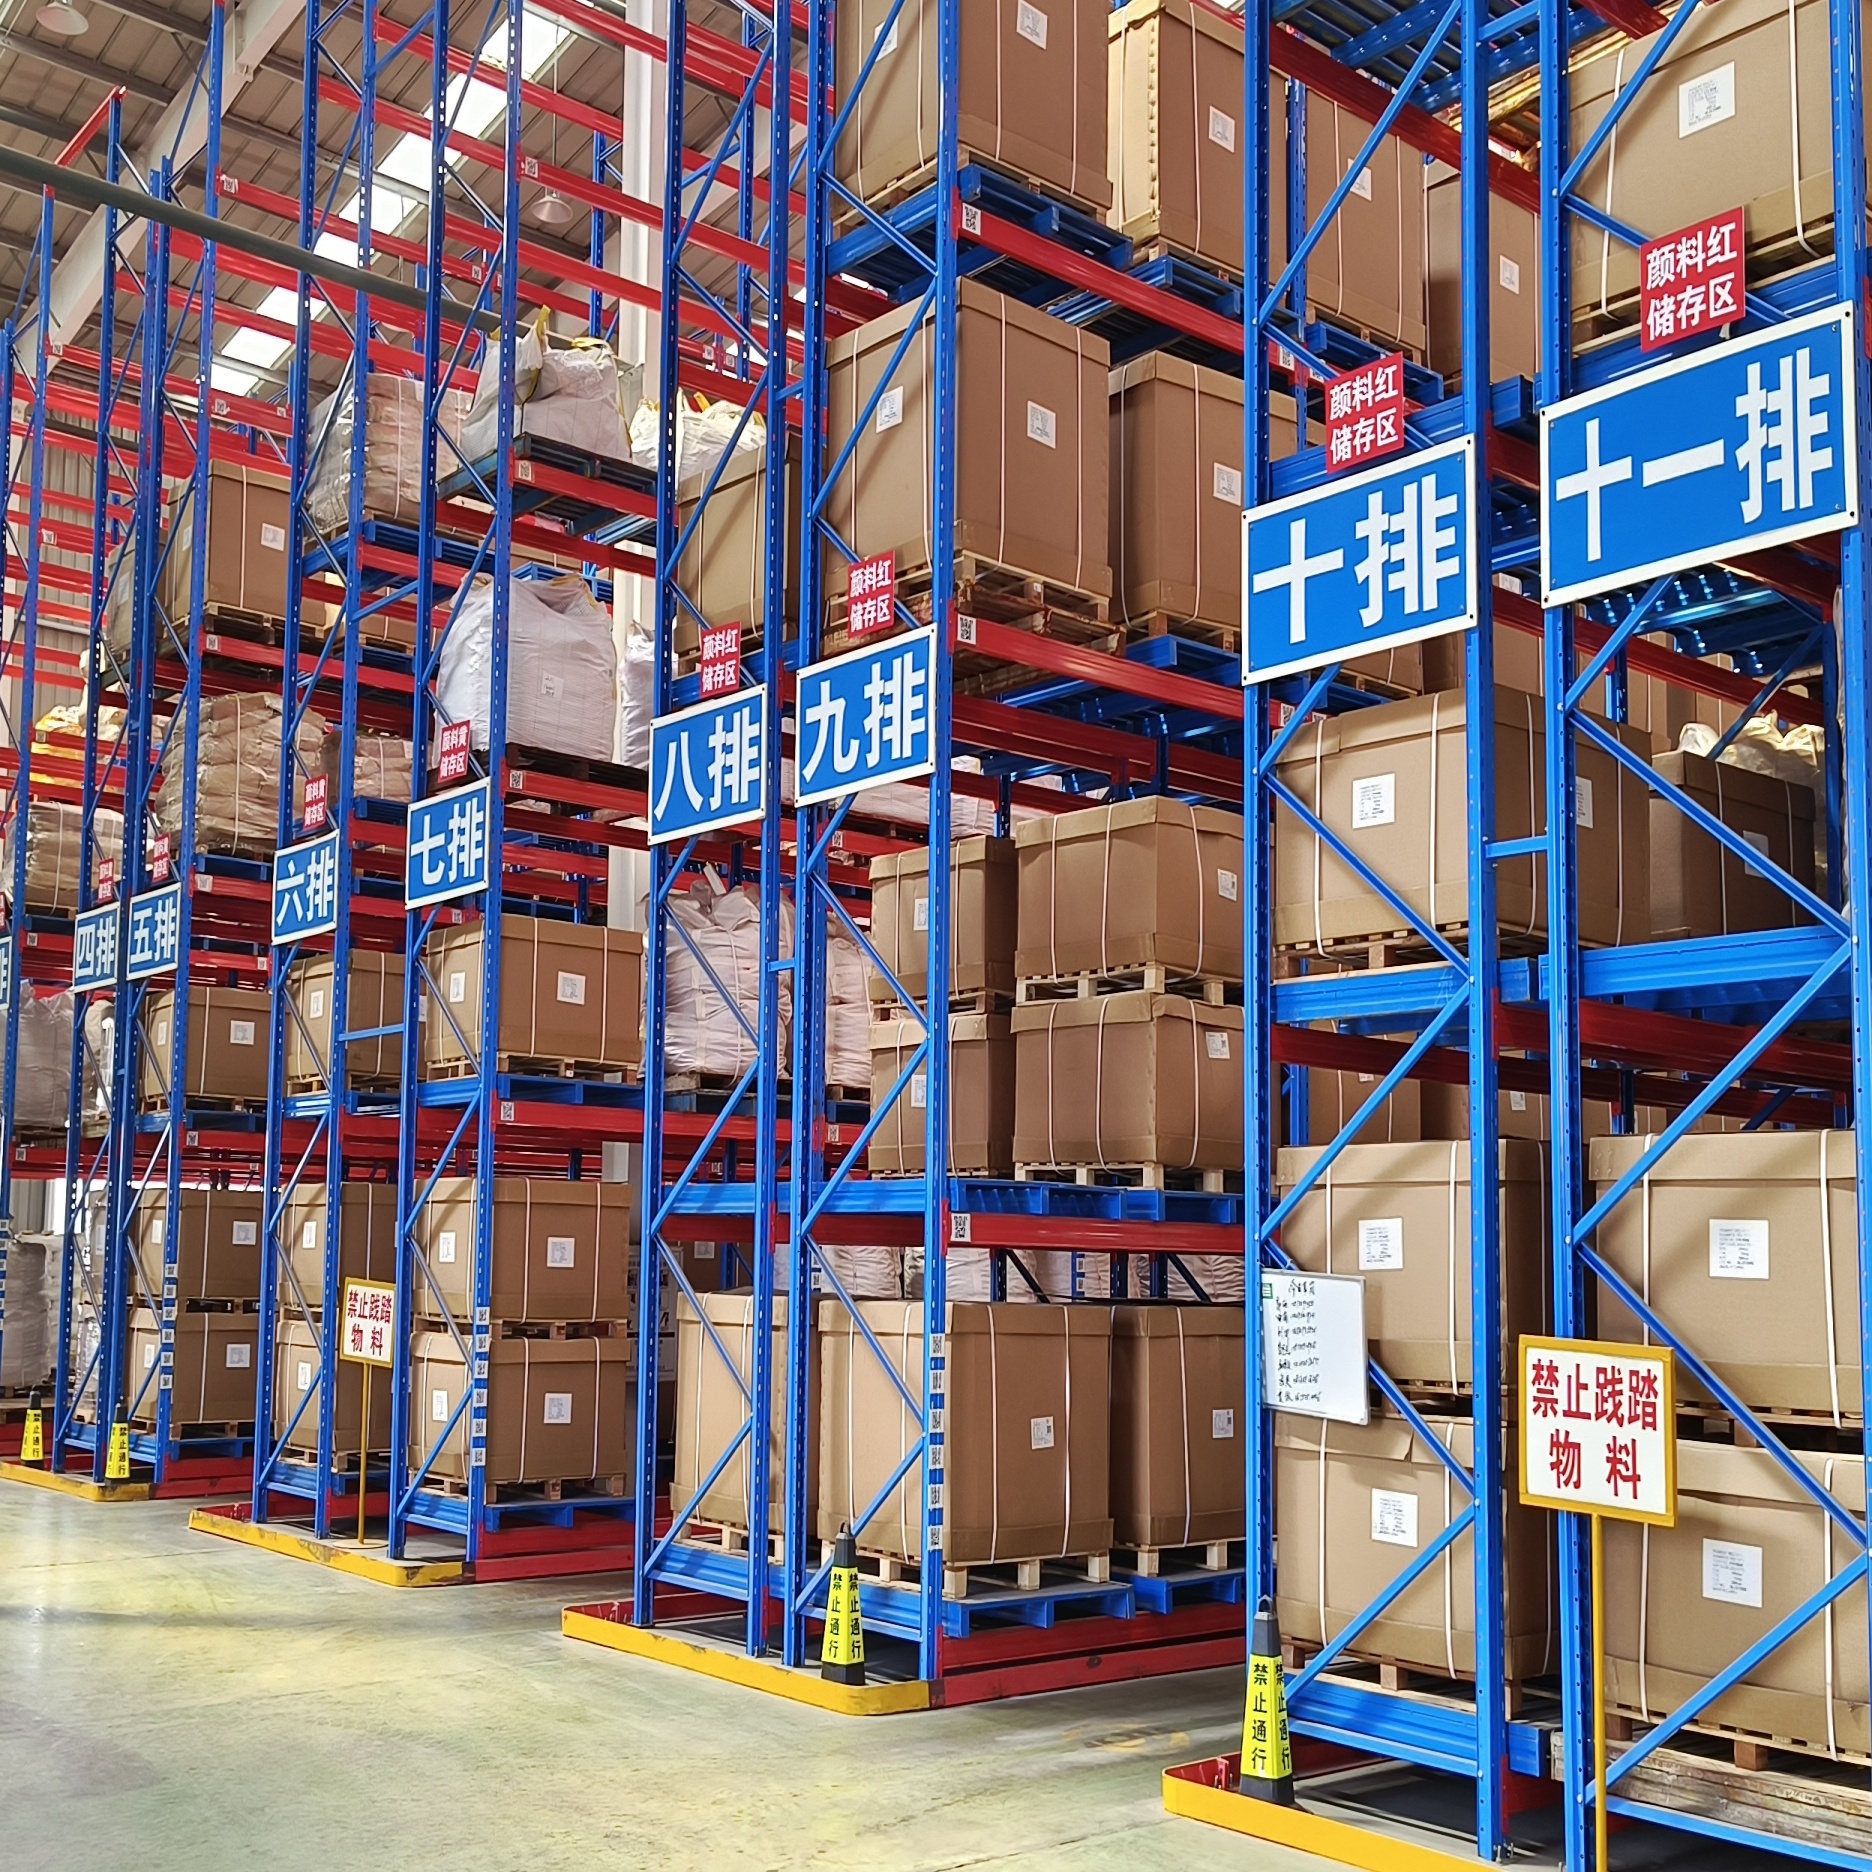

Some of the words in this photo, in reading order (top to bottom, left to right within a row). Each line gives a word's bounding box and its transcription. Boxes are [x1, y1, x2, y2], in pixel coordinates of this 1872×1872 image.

[1646, 222, 1738, 291] 颜料红
[1646, 272, 1738, 341] 储存区
[1329, 364, 1399, 421] 颜料红
[1330, 407, 1399, 465] 储存区
[1556, 346, 1833, 562] 十一排
[850, 559, 892, 598] 颜料红
[1253, 473, 1460, 644] 十排
[702, 628, 738, 661] 颜料红
[850, 594, 891, 633] 储存区
[702, 660, 737, 692] 储存区
[801, 651, 926, 783] 九排
[654, 706, 760, 822] 八排
[411, 797, 484, 886] 七排
[276, 845, 334, 927] 六排
[75, 915, 116, 979] 四排
[130, 896, 177, 965] 五排
[347, 1289, 392, 1324] 禁止践踏
[351, 1323, 383, 1356] 物料
[1531, 1358, 1659, 1431] 禁止践踏
[118, 1427, 128, 1475] 禁止通行
[1549, 1428, 1641, 1499] 物料
[828, 1573, 843, 1658] 禁止通行
[848, 1573, 861, 1658] 禁止通行
[1251, 1663, 1269, 1770] 禁止通行
[1275, 1662, 1290, 1771] 禁止通行
